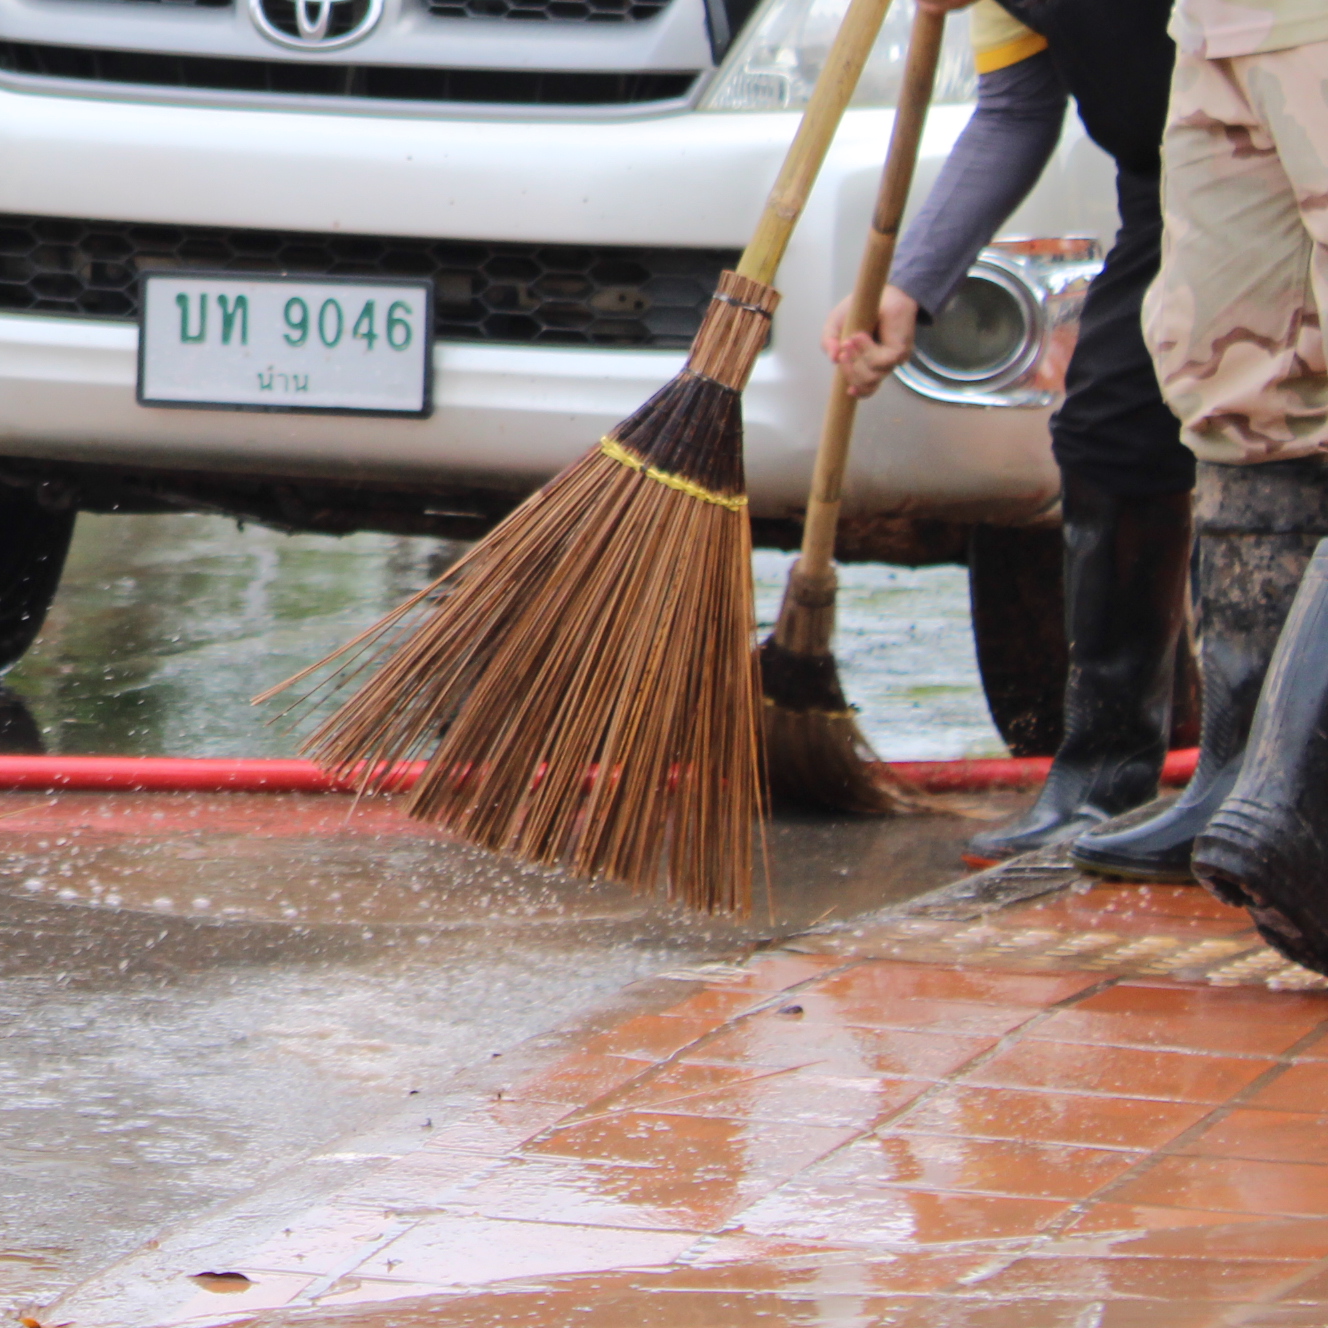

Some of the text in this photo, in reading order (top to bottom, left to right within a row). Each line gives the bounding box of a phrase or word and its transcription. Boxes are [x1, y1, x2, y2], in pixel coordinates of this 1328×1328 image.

[175, 291, 414, 352] บท 9046
[257, 365, 310, 393] น่าน
